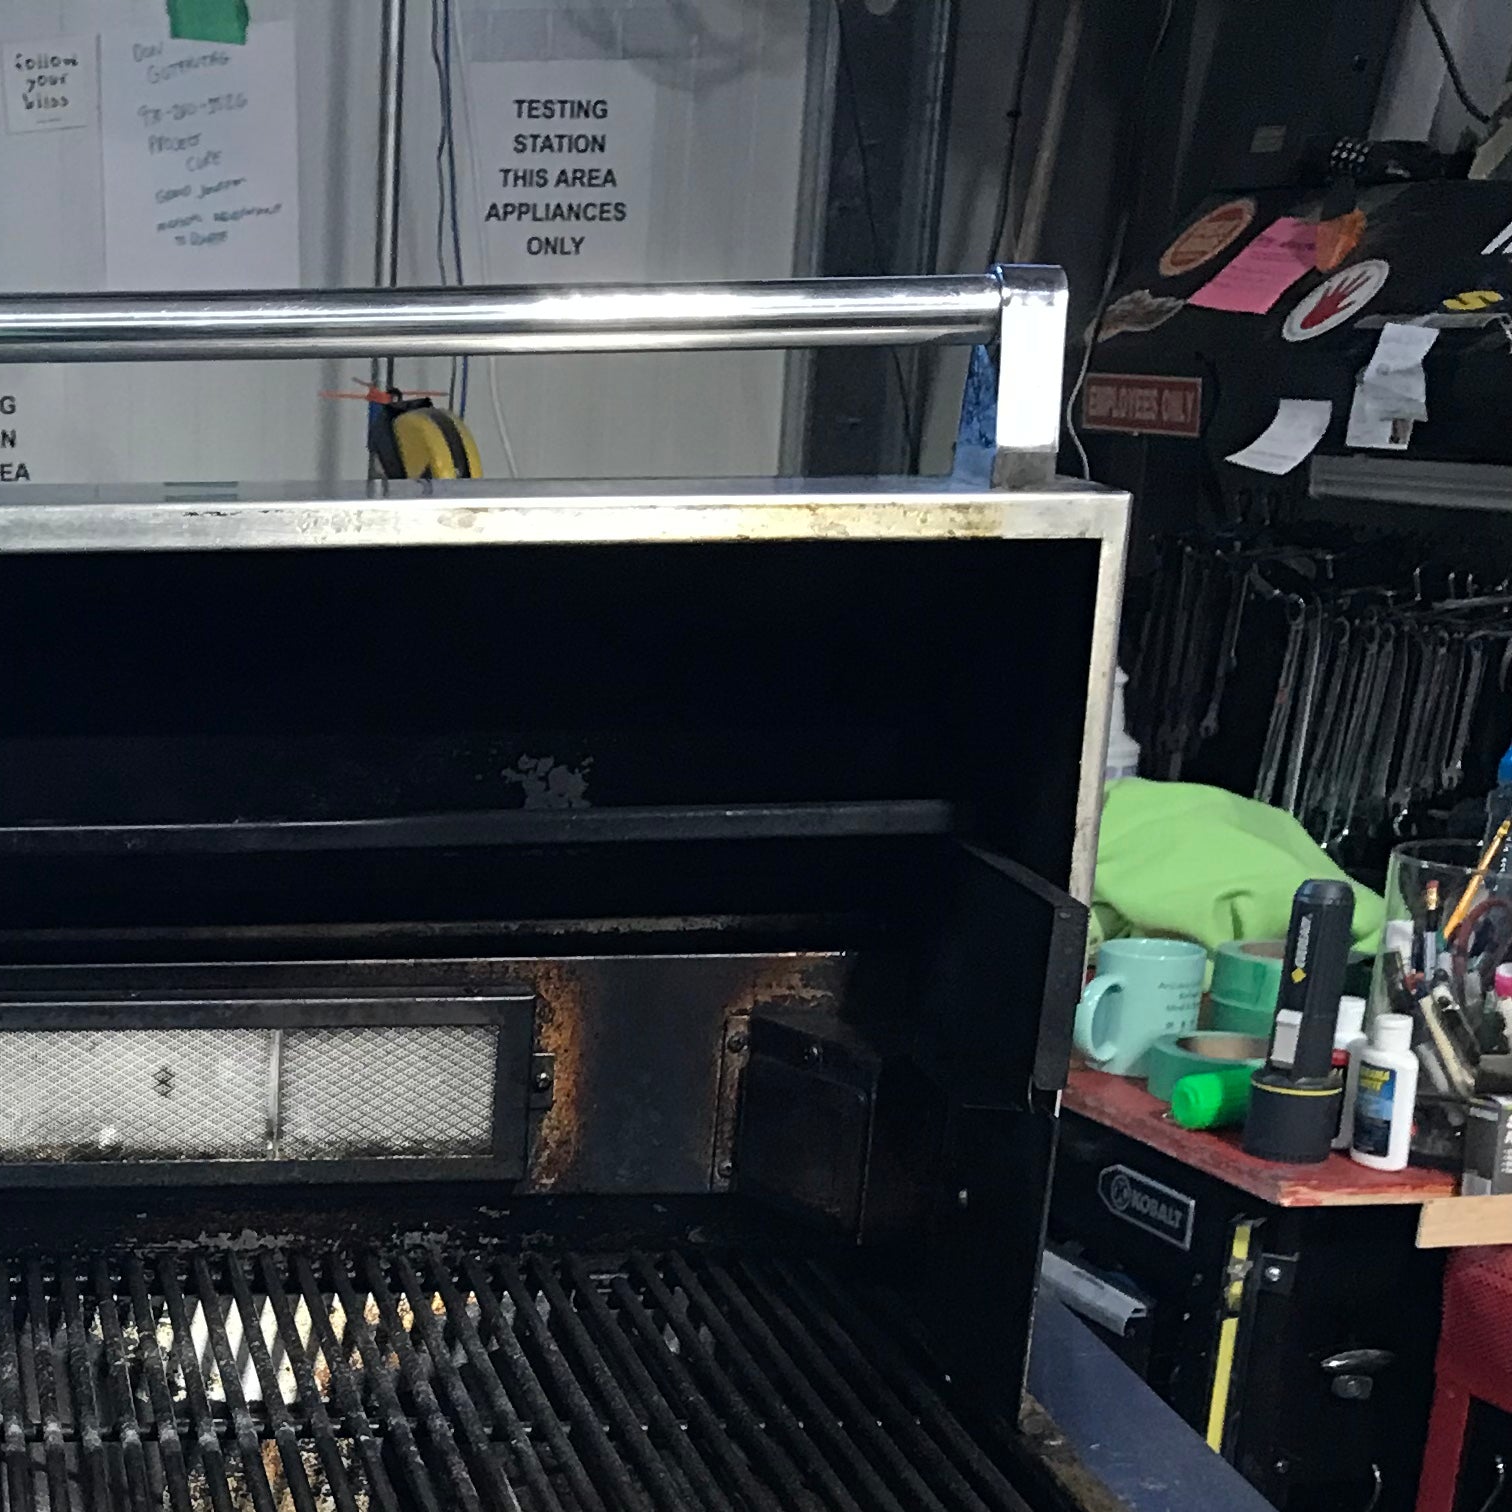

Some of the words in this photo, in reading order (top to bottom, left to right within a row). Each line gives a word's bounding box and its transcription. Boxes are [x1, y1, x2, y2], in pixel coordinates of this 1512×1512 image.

[513, 99, 609, 120] TESTING
[512, 133, 607, 154] STATION
[498, 168, 549, 188] THIS
[554, 168, 618, 188] AREA
[484, 202, 628, 222] APPLIANCES
[526, 236, 586, 256] ONLY
[1131, 1190, 1183, 1229] KOBALT
